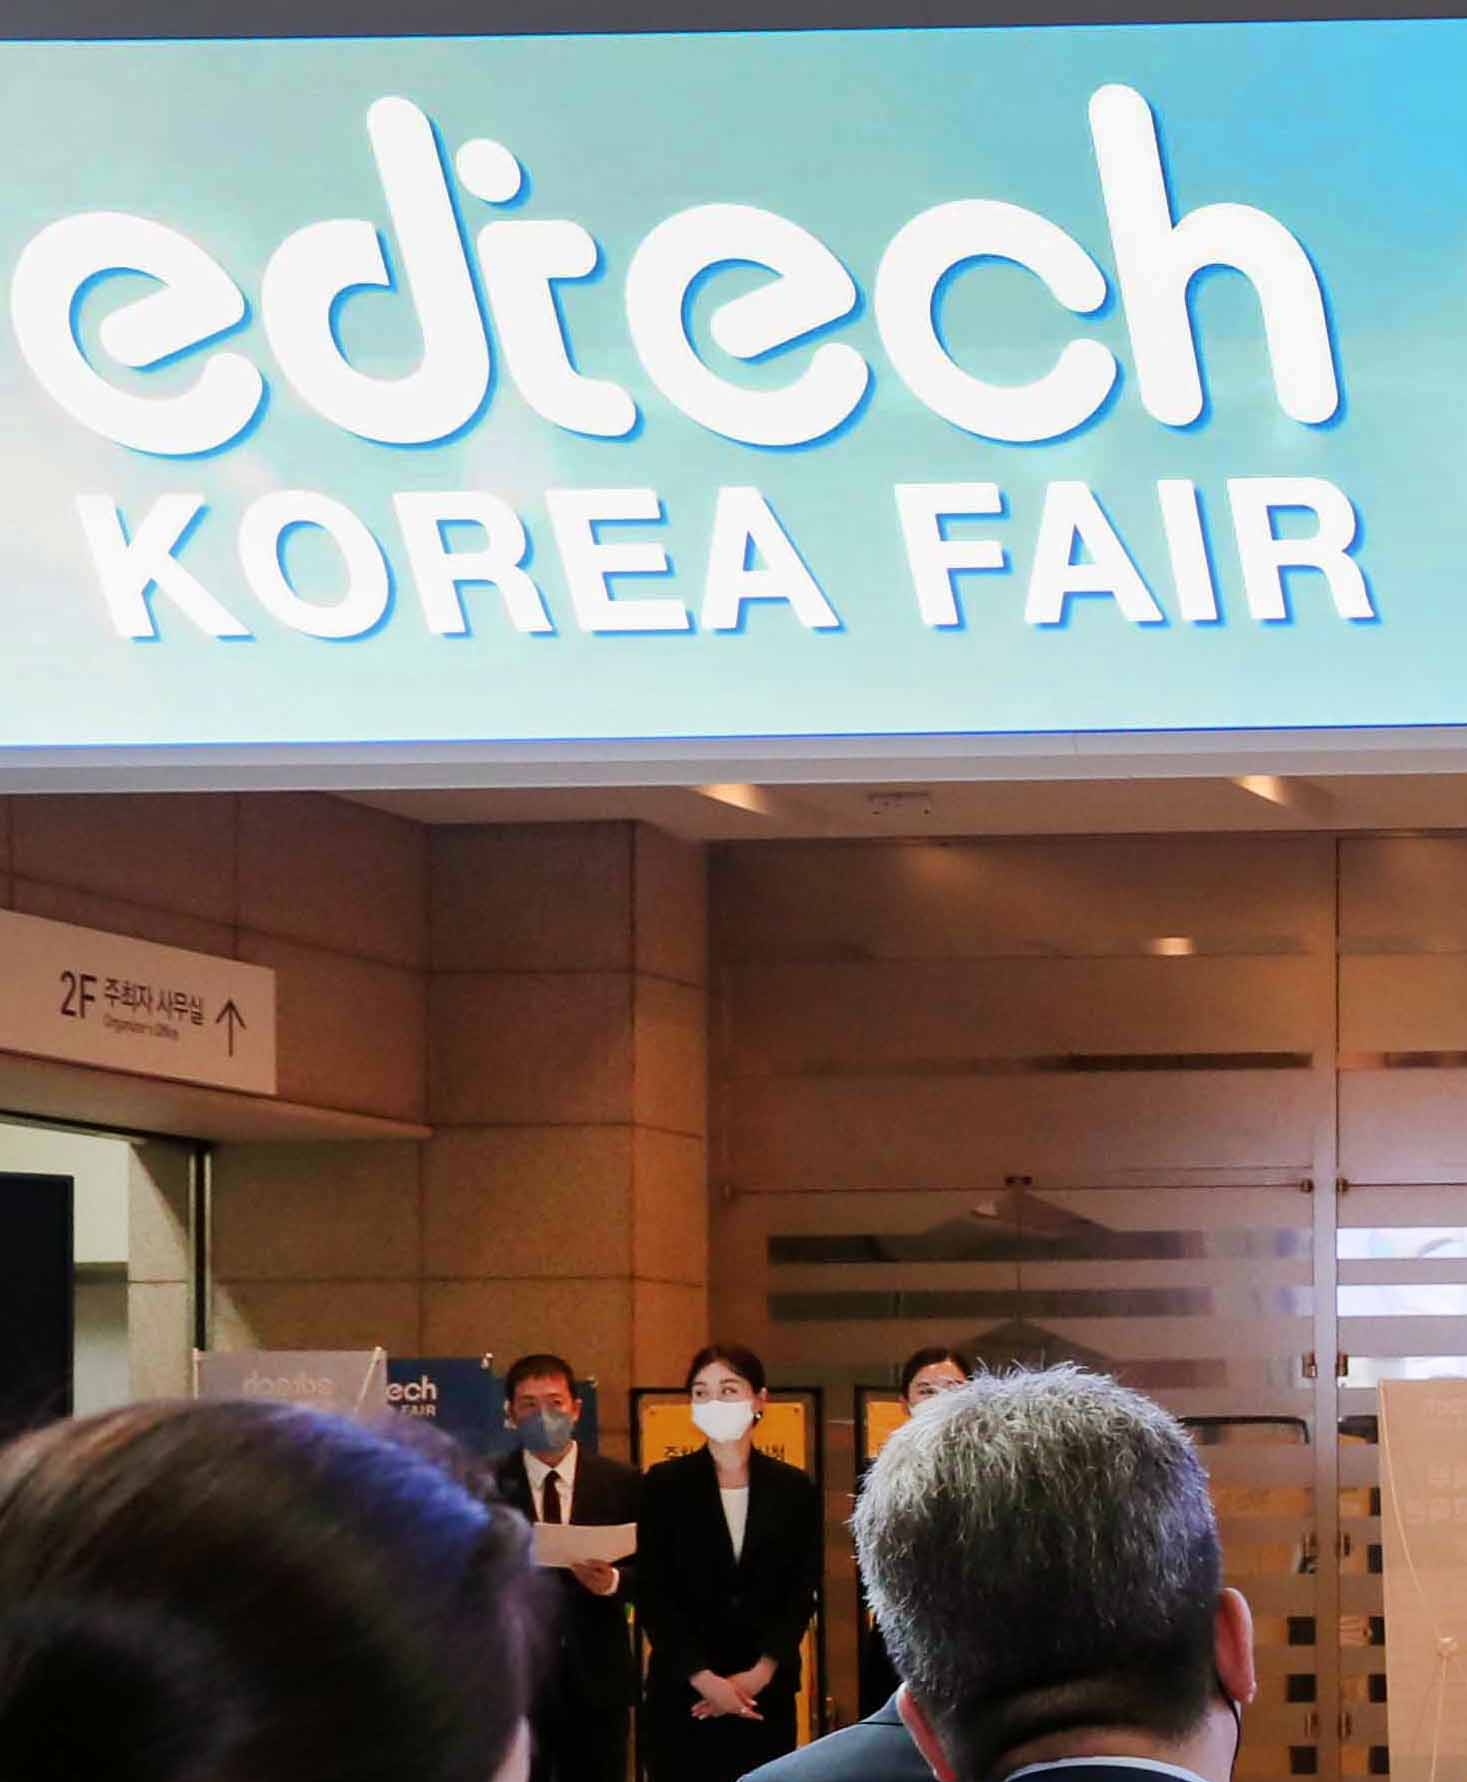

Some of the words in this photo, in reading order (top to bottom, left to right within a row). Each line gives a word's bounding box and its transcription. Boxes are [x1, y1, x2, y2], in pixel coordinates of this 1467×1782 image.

[12, 84, 1338, 455] edtech
[76, 486, 840, 640] KOREA
[893, 477, 1374, 628] FAIR
[61, 969, 97, 1018] 2F
[157, 990, 204, 1026] 사무실
[384, 1375, 438, 1402] ech
